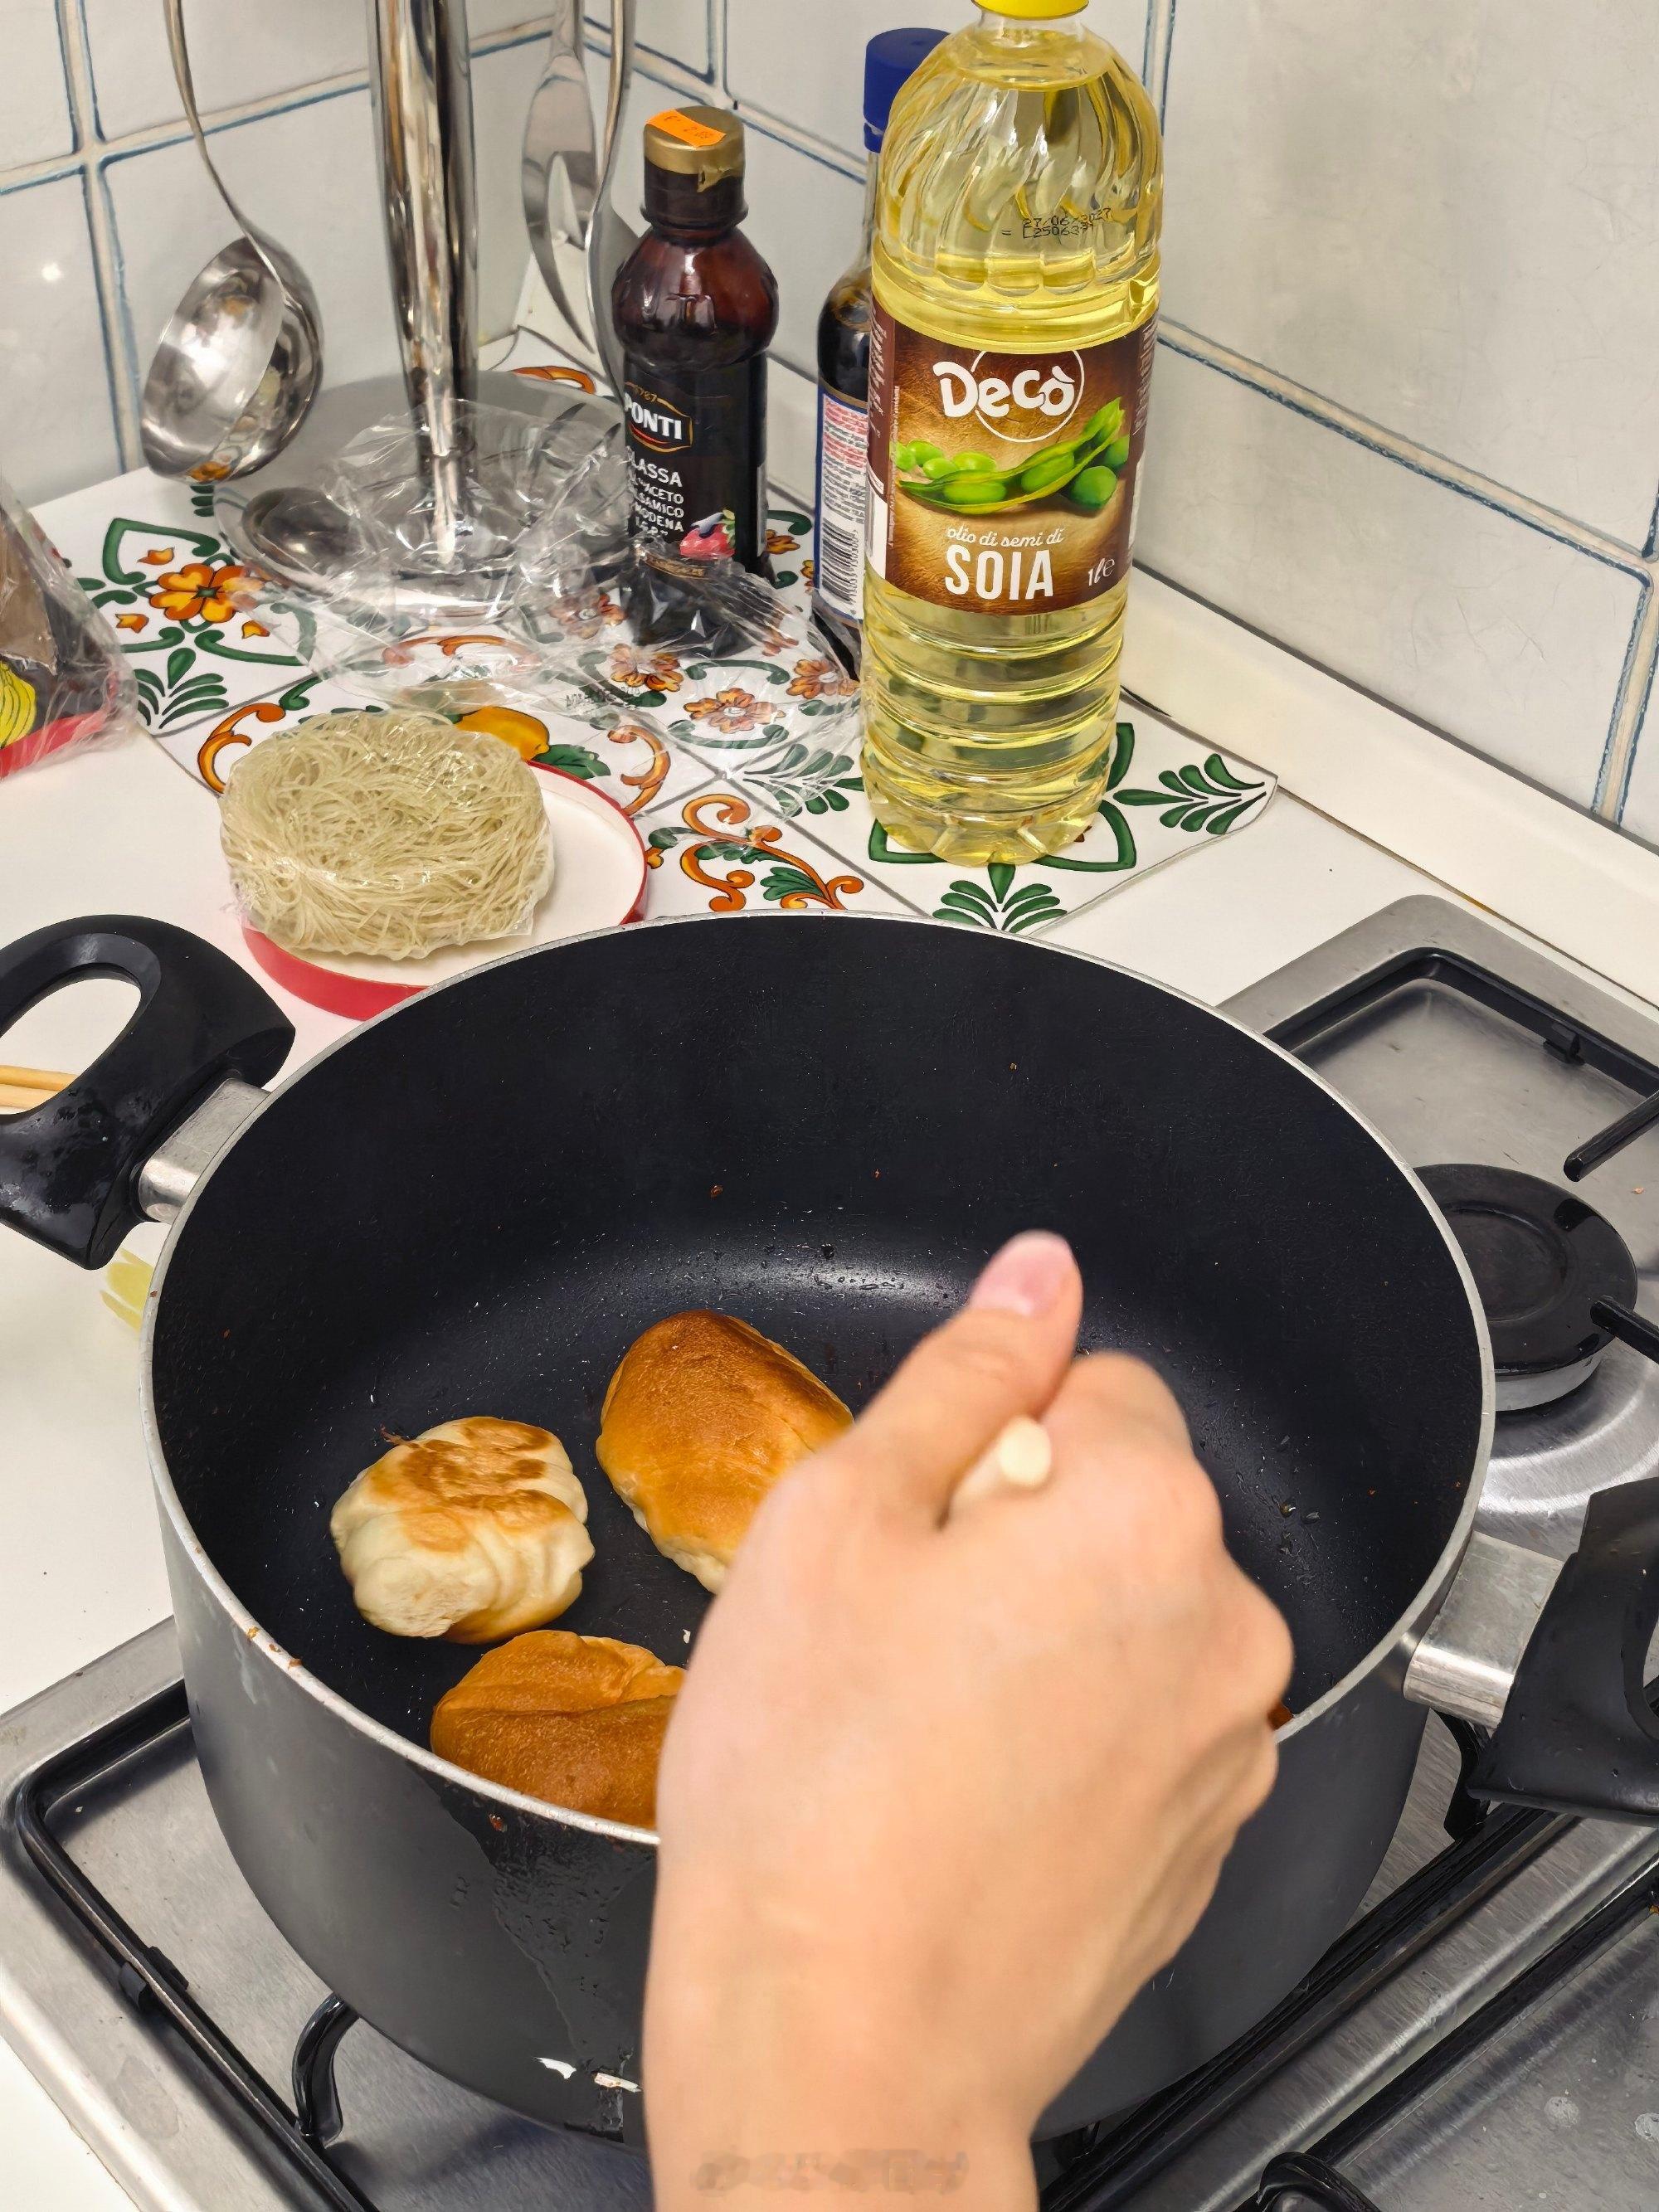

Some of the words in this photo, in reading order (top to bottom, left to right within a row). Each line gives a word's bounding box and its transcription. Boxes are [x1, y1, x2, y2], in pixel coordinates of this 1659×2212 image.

[628, 450, 684, 488] LASSA
[946, 523, 977, 543] olio
[979, 531, 999, 547] di
[1000, 532, 1044, 547] semi
[1046, 526, 1065, 545] di
[944, 544, 1054, 600] SOIA
